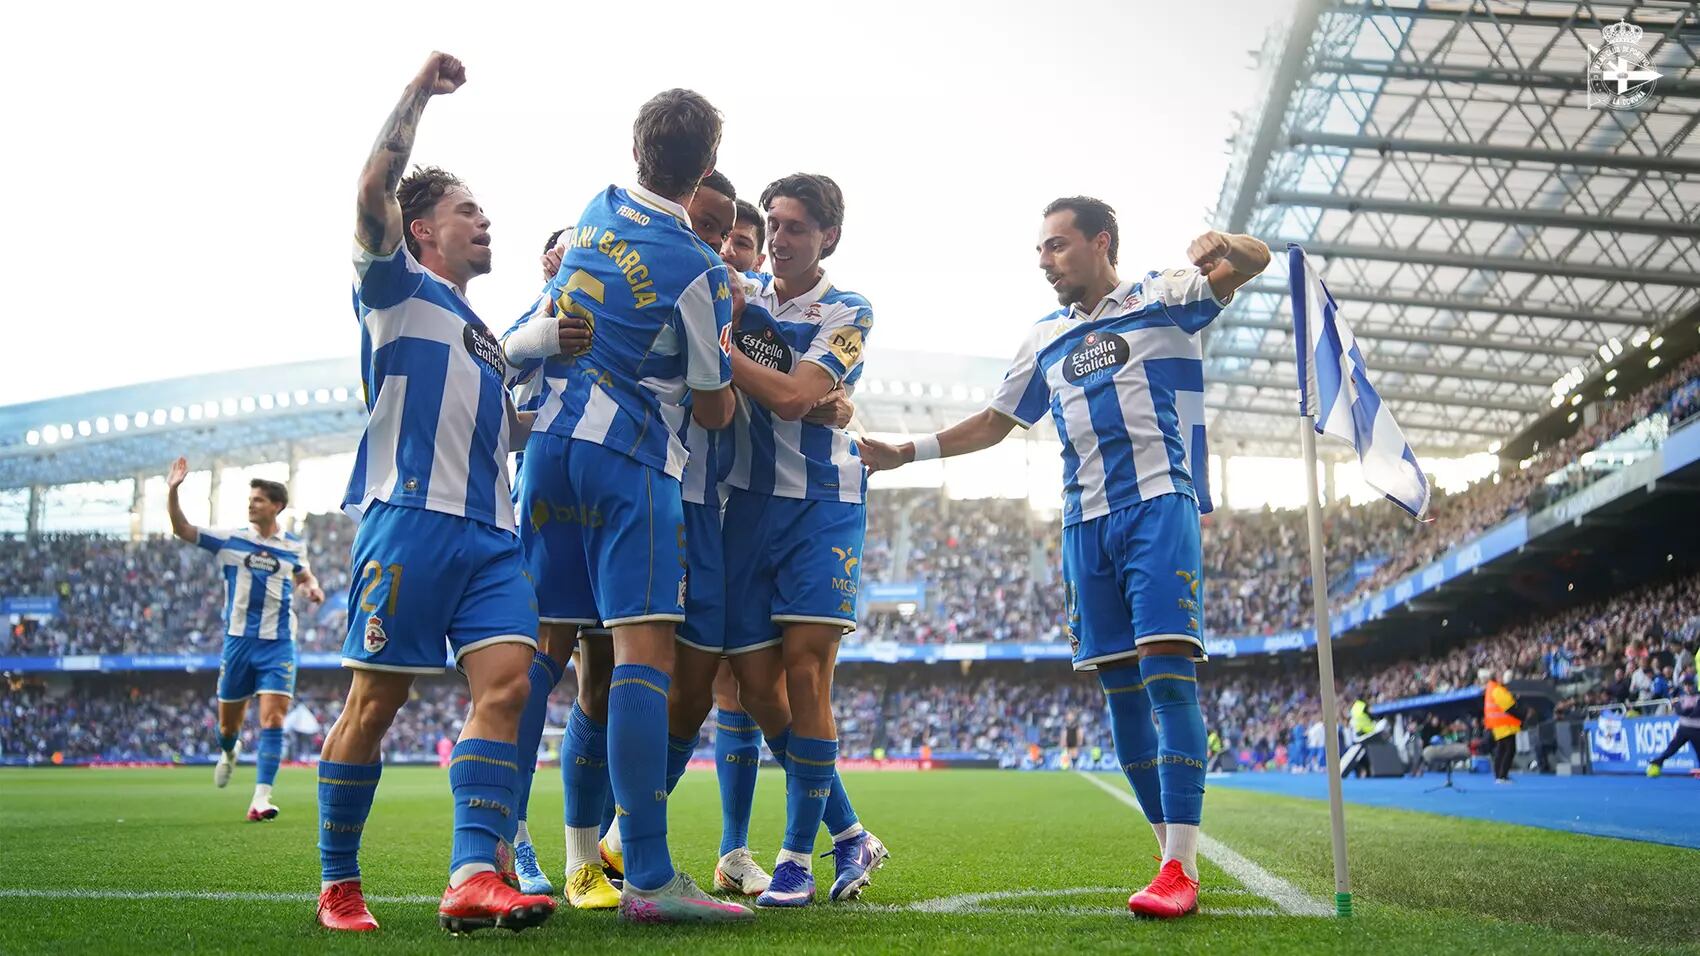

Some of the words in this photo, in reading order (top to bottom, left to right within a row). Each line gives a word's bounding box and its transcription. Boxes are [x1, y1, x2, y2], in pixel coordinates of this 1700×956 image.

[616, 204, 651, 226] FEIRACO
[570, 226, 597, 248] ANI
[598, 230, 657, 309] BARCIA
[472, 329, 501, 356] Estrel
[741, 334, 783, 360] Estrella
[1072, 340, 1116, 366] Estrella
[1074, 354, 1116, 376] Galicia
[360, 559, 403, 616] 21
